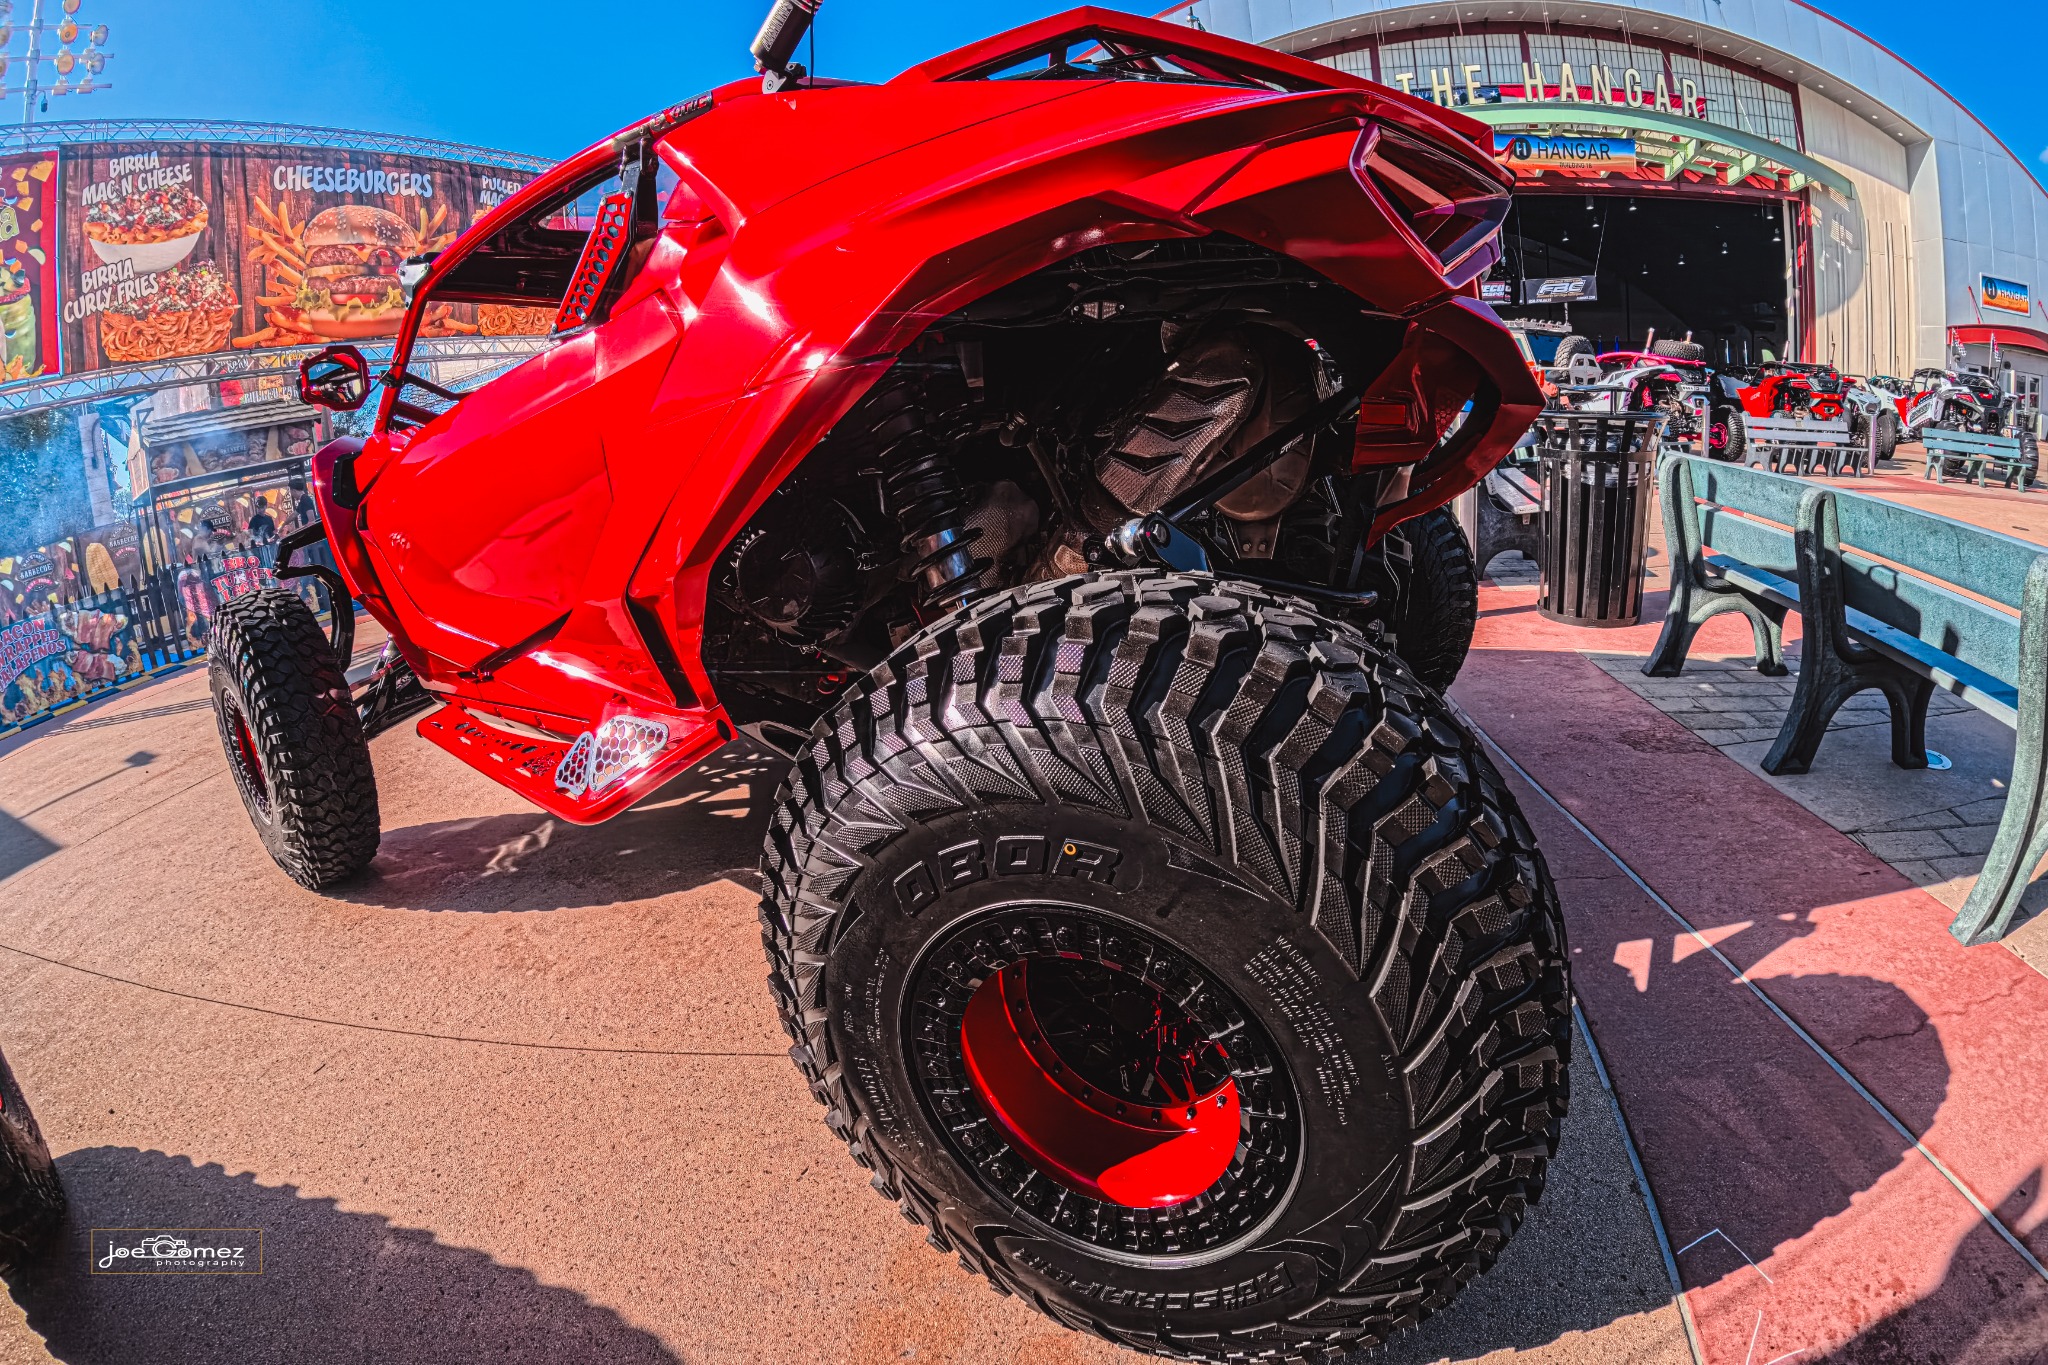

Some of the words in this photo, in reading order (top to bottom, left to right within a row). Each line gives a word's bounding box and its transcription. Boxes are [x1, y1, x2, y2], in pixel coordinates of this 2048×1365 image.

[1395, 64, 1482, 108] THE
[1521, 61, 1700, 119] HANGAR
[109, 150, 160, 178] BIRRIA
[1537, 141, 1611, 160] HANGAR
[82, 179, 117, 206] MAC
[121, 175, 134, 197] N
[137, 163, 193, 192] CHEESE
[273, 165, 433, 198] CHEESEBURGERS
[81, 258, 135, 293] BIRRIA
[63, 286, 113, 323] CURLY
[116, 272, 159, 304] FRIES
[0, 618, 45, 650] ACON
[893, 835, 1124, 918] OBOR
